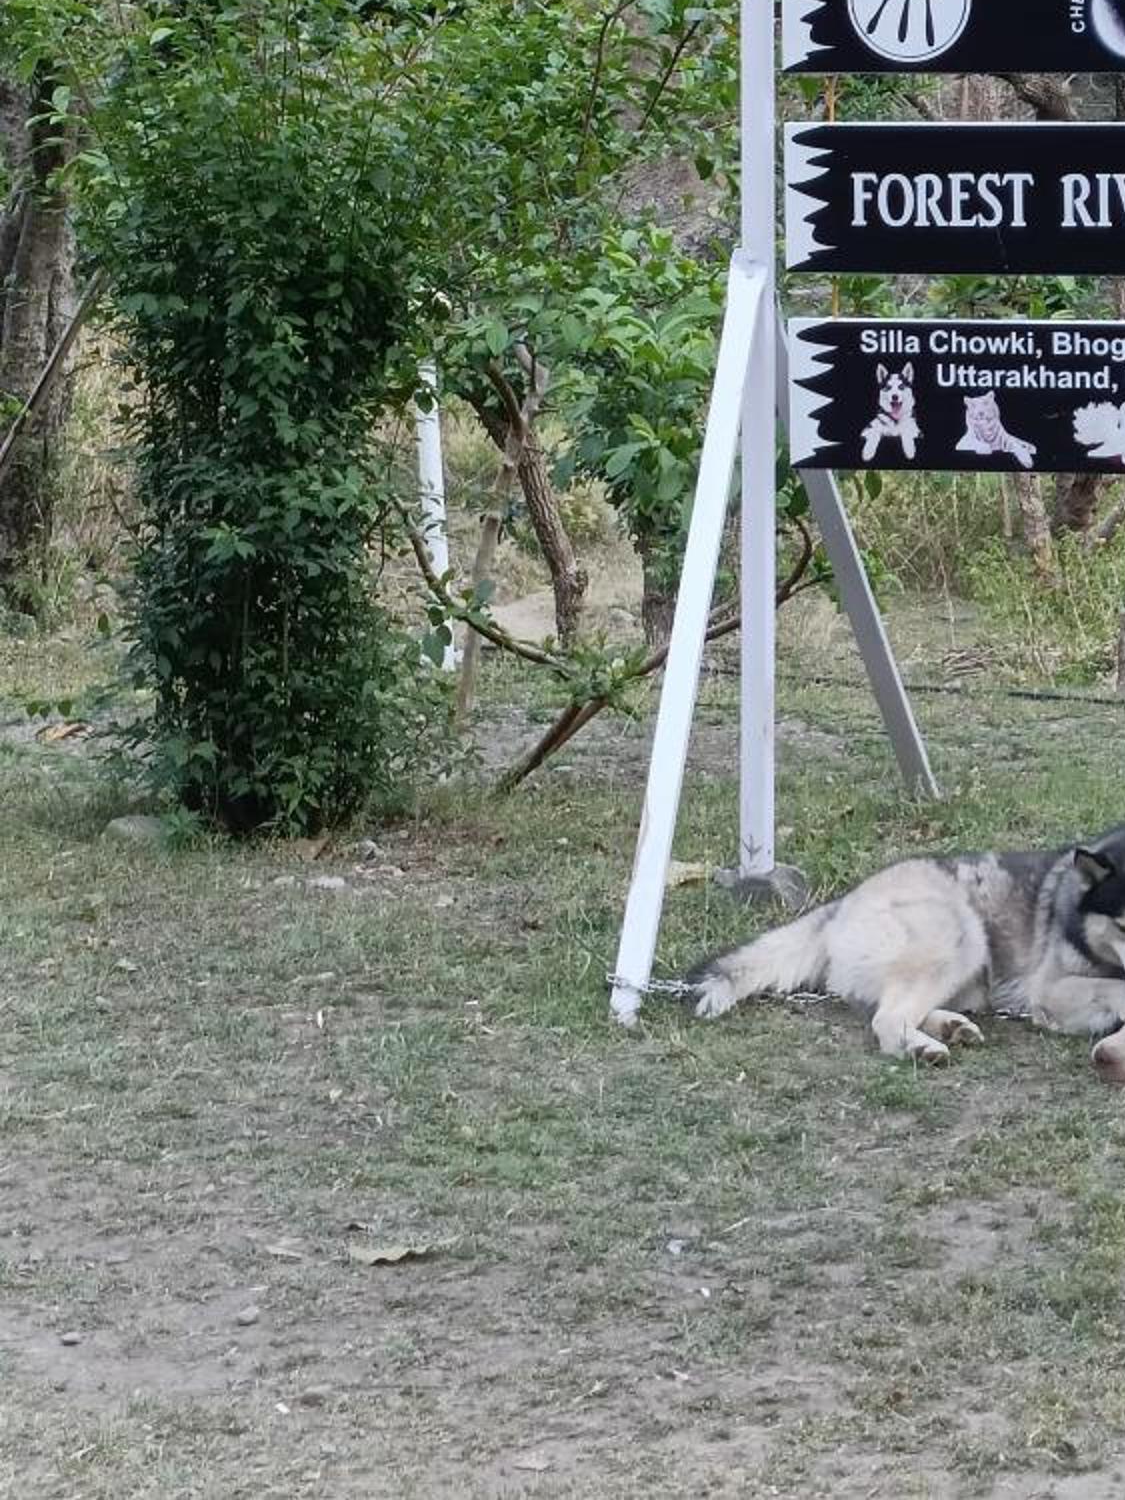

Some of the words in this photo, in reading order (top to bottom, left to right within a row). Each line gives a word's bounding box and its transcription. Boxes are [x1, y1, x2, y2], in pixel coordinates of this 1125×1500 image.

[850, 172, 1035, 228] FOREST
[860, 329, 921, 354] Silla
[929, 329, 1043, 359] Chowki,
[937, 363, 1118, 393] Uttarakhand,
